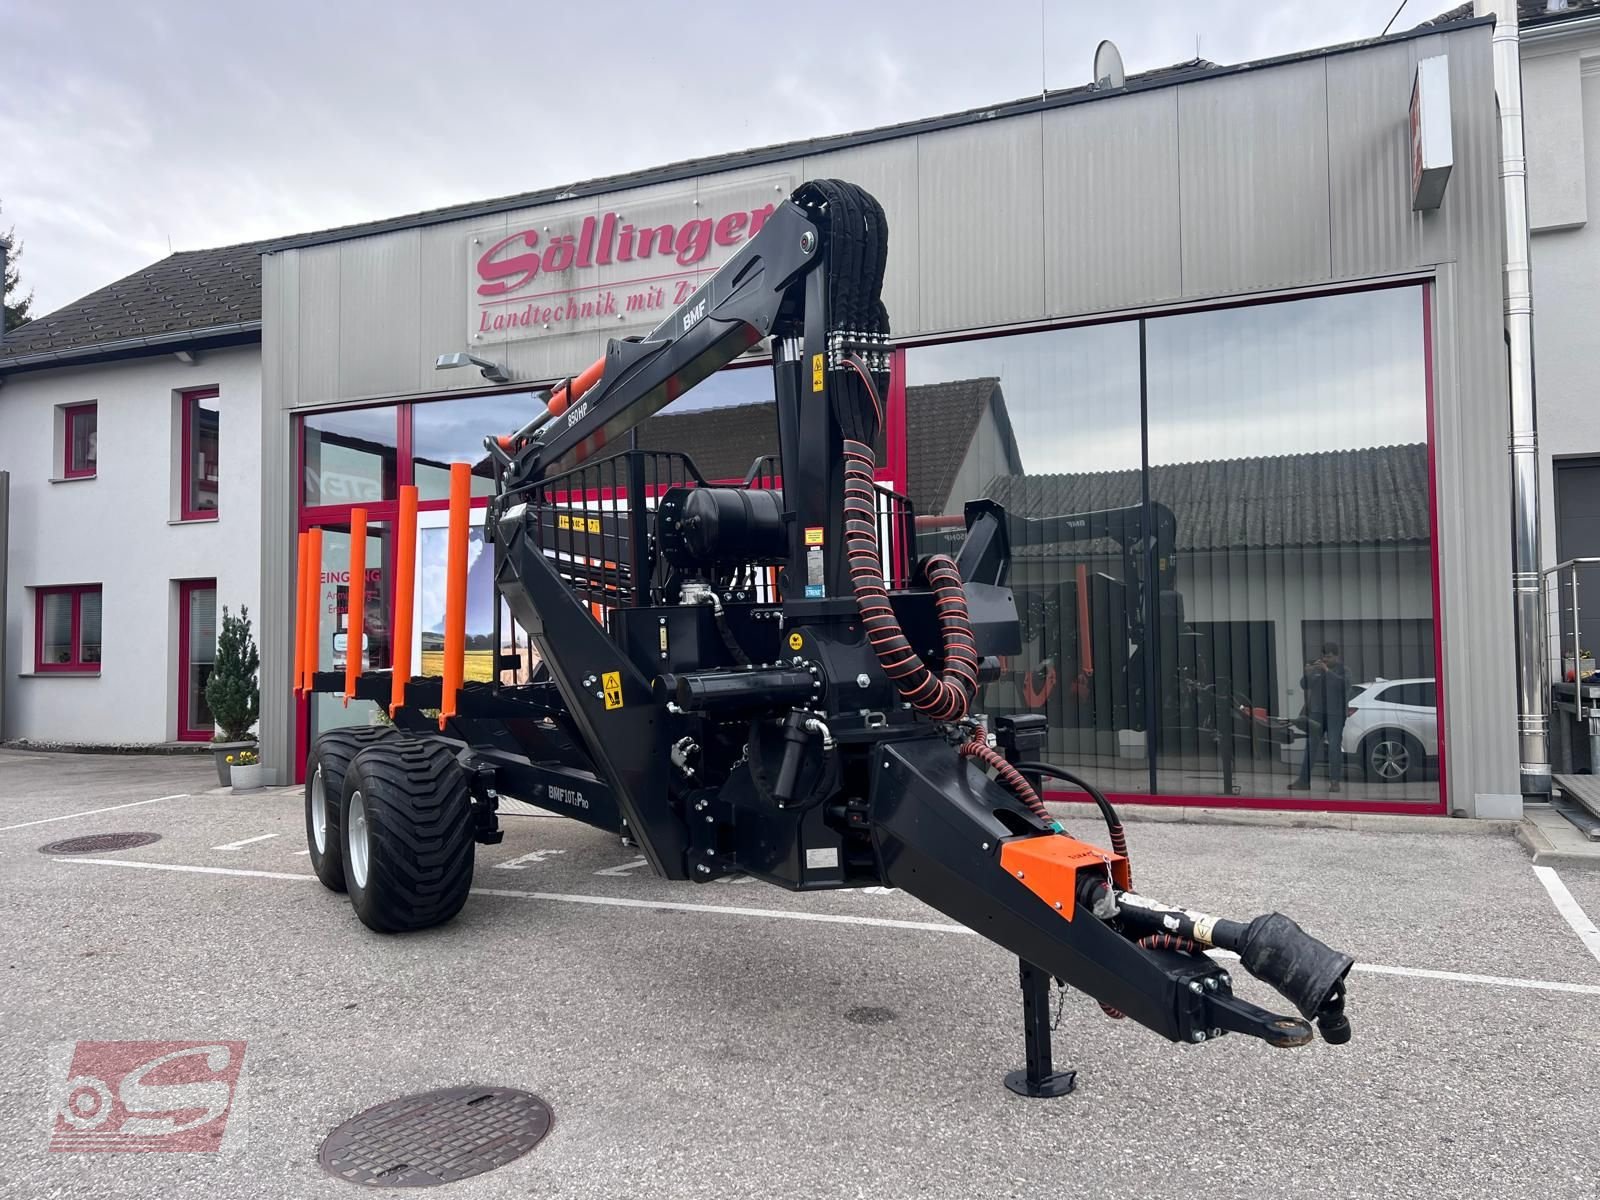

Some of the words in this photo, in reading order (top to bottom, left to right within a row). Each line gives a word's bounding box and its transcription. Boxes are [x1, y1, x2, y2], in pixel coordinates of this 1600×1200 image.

[477, 203, 774, 296] Söllinger
[479, 300, 616, 332] Landtechnik
[626, 286, 662, 312] mit
[672, 280, 697, 305] Z
[683, 298, 706, 331] BMF
[320, 570, 382, 584] EINGNG
